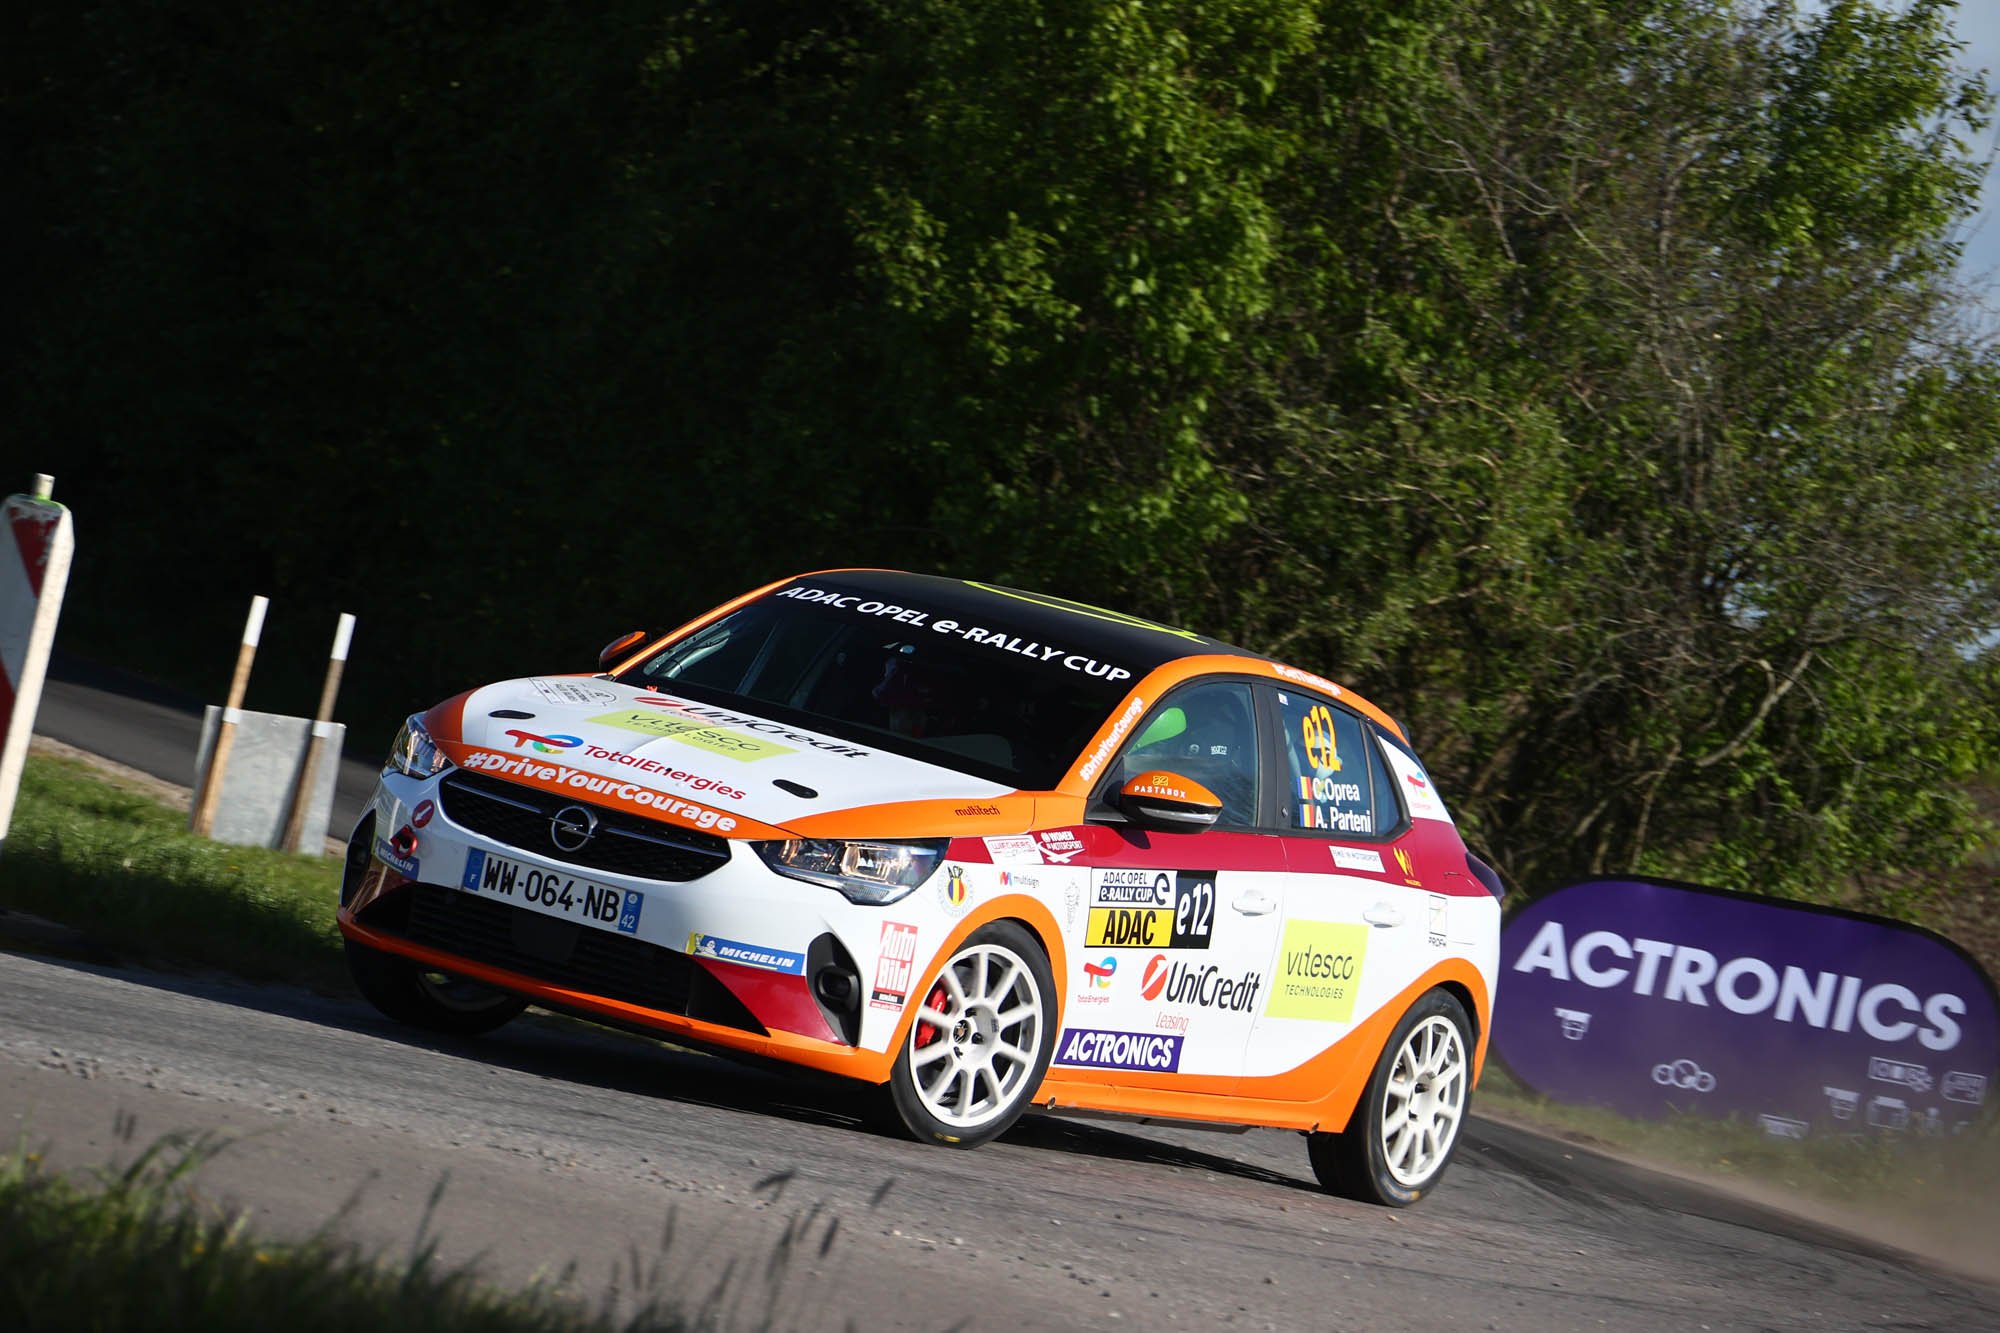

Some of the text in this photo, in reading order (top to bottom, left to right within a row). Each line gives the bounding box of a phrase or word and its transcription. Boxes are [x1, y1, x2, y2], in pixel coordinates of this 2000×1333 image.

[776, 587, 1132, 681] ADAC OPEL e-RALLY CUP
[682, 707, 871, 758] UniCredit
[1079, 697, 1144, 782] #DriveYourCourage
[1302, 705, 1342, 772] e12
[584, 744, 747, 800] TotalEnergies
[463, 751, 737, 832] #DriveYourCourage
[1134, 785, 1186, 799] PASTABOX
[1325, 778, 1361, 807] Oprea
[954, 805, 1001, 817] multitech
[1315, 805, 1372, 833] A. Parteni
[469, 873, 477, 884] F
[482, 857, 621, 923] WW-064-NB
[1100, 887, 1153, 902] e-RALLY CUP
[1103, 872, 1148, 885] ADAC OPEL
[620, 913, 635, 929] 42
[1176, 882, 1213, 936] e12
[1102, 910, 1156, 945] ADAC
[718, 946, 796, 968] MICHELIN
[1287, 944, 1354, 980] vitesco
[1166, 961, 1261, 1013] UniCredit
[1285, 984, 1344, 999] TECHNOLOGIES
[1513, 920, 1967, 1051] ACTRONICS
[1155, 1011, 1190, 1035] Leasing
[1063, 1031, 1175, 1068] ACTRONICS
